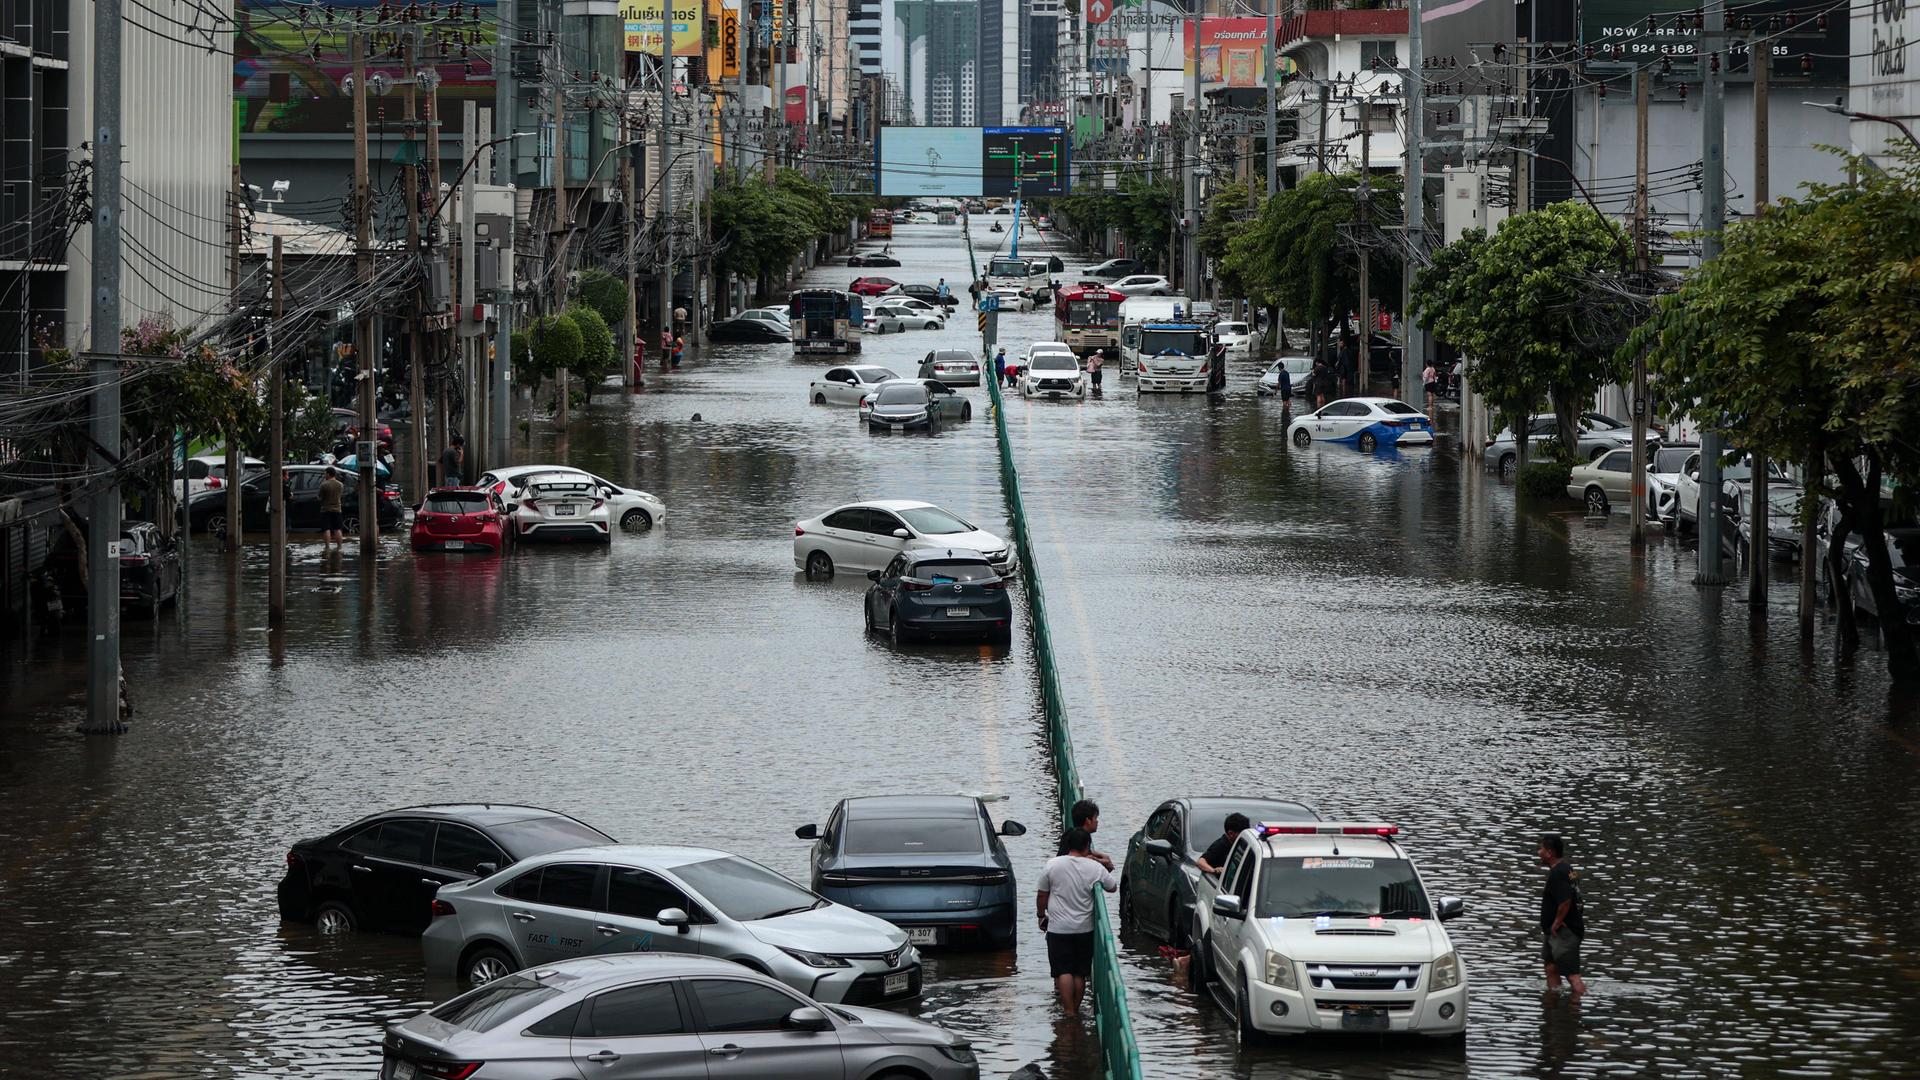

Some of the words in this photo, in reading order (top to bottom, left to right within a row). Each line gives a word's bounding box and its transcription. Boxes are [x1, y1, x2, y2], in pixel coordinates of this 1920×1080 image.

[1602, 27, 1638, 37] NOW
[1645, 28, 1697, 37] RRVI
[1631, 44, 1656, 54] 924
[110, 545, 117, 554] 5
[918, 929, 931, 937] 307
[527, 933, 549, 944] FAST
[560, 937, 584, 948] FIRST
